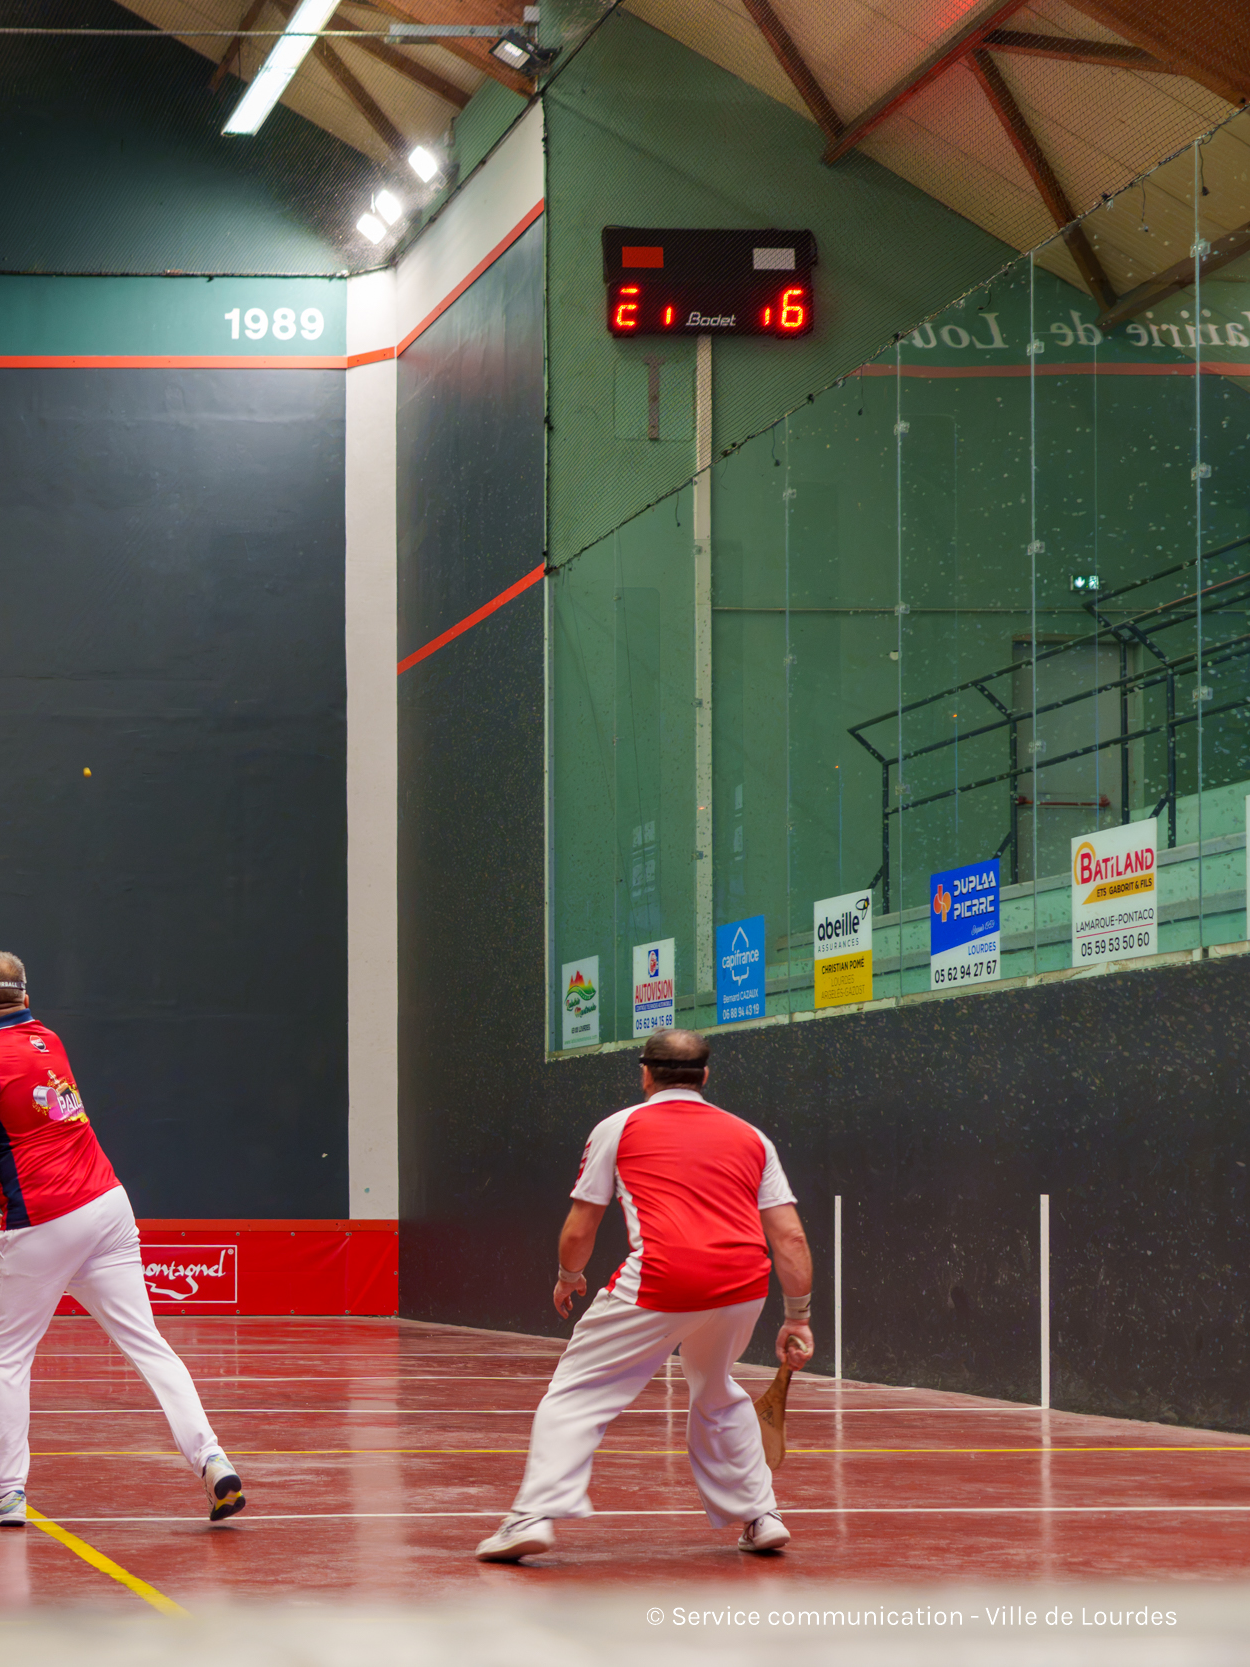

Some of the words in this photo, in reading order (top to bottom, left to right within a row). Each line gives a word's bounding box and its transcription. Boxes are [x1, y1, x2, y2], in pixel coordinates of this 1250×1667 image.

[224, 307, 325, 340] 1989
[685, 311, 737, 327] Bodet
[953, 870, 997, 897] DUPLAA
[1096, 887, 1107, 898] ETS
[1108, 881, 1135, 895] GABORIT
[1134, 880, 1140, 889] &
[1140, 877, 1153, 888] FILS
[953, 894, 995, 921] PIERRE
[817, 911, 860, 941] abeille
[1075, 907, 1155, 933] LAMARQUE-PONTACQ
[817, 937, 860, 953] ASSURANCES
[967, 941, 997, 956] LOURDES
[1081, 942, 1093, 957] 05
[1094, 939, 1106, 954] 59
[1108, 936, 1120, 952] 53
[1122, 934, 1135, 949] 50
[1137, 931, 1150, 947] 60
[722, 948, 760, 972] capifrance
[821, 961, 849, 975] CHRISTIAN
[849, 955, 865, 970] POMÉ
[934, 968, 945, 984] 05
[947, 966, 958, 982] 62
[960, 963, 971, 980] 94
[973, 961, 984, 977] 27
[986, 959, 997, 975] 67
[634, 979, 673, 1004] AUTOVISION
[830, 974, 855, 987] LOURDES
[723, 991, 740, 1004] Bernard
[635, 1018, 642, 1030] 05
[643, 1017, 650, 1029] 62
[651, 1016, 658, 1028] 94
[665, 1014, 673, 1025] 69
[141, 1249, 227, 1299] ontagnel
